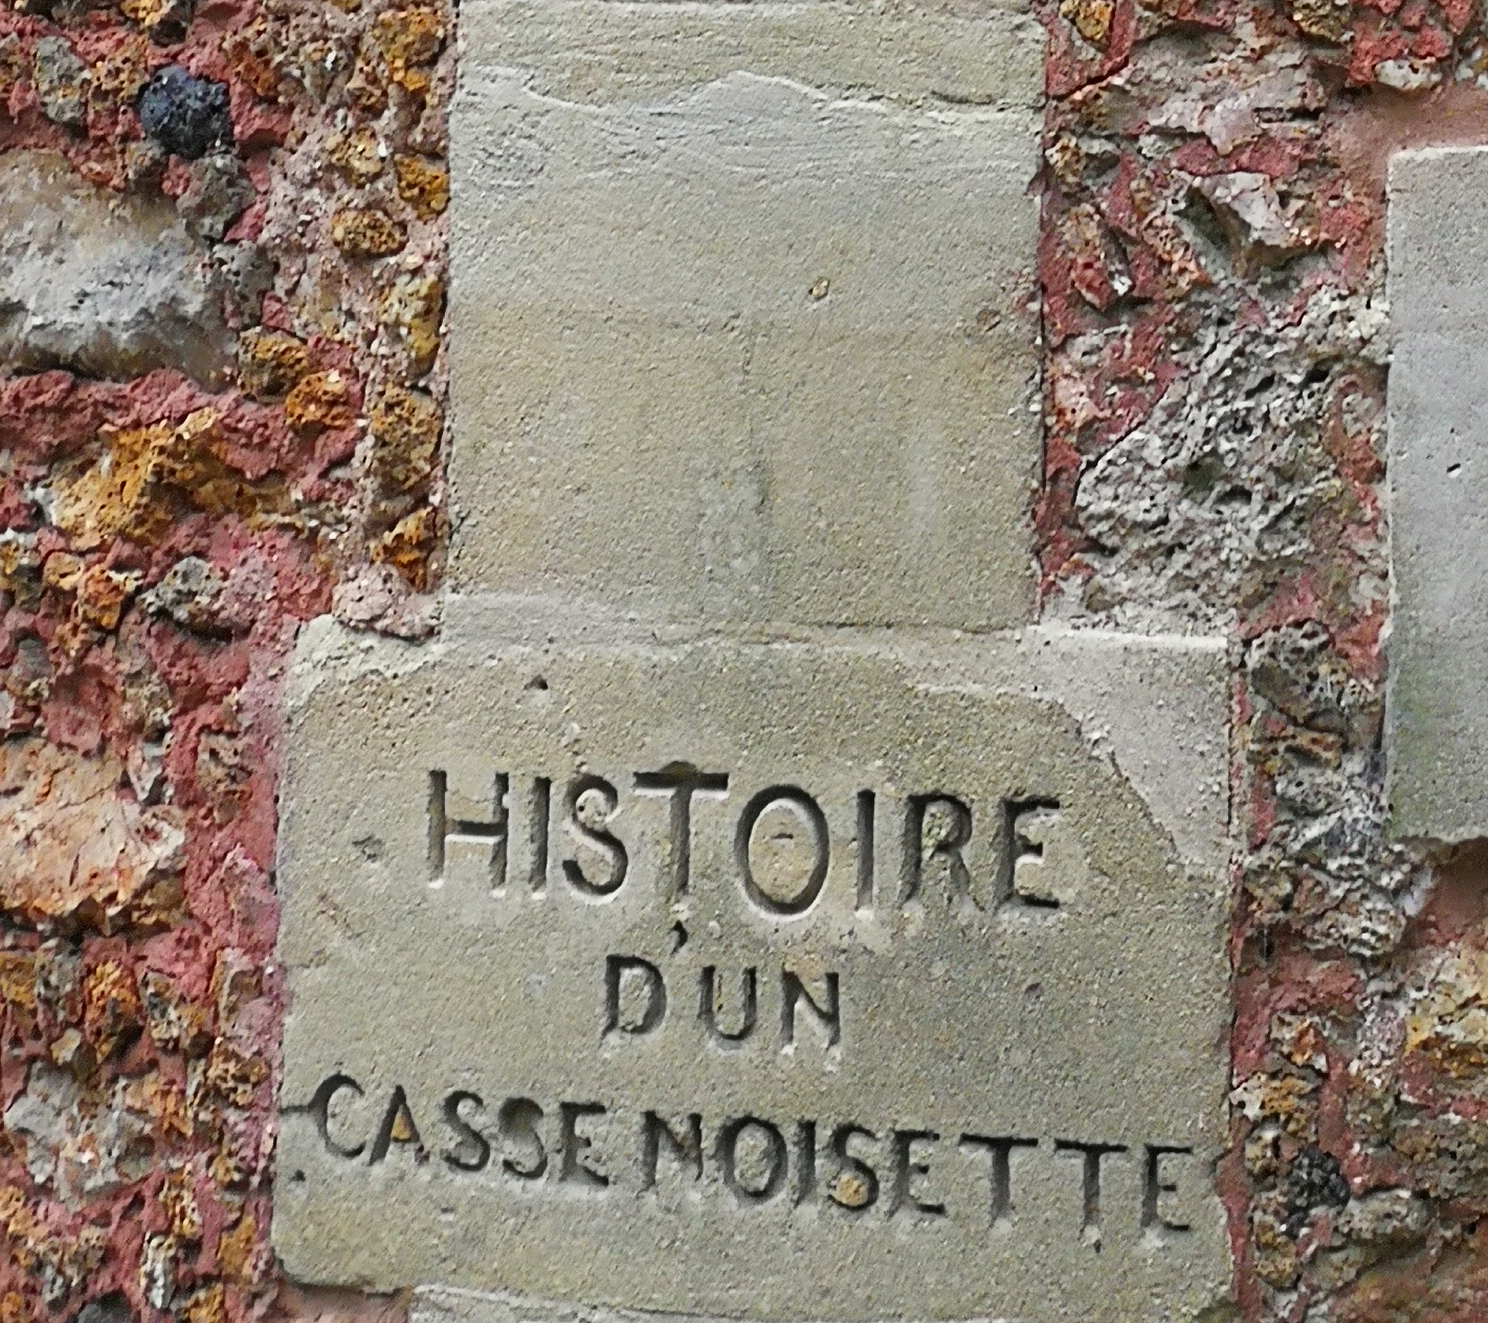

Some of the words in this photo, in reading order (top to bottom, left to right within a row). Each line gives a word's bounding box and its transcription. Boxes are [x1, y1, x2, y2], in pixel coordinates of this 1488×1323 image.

[427, 762, 1061, 916] HISTOIRE
[603, 921, 842, 1050] D'UN
[314, 1074, 610, 1189] CASSE
[640, 1109, 1192, 1237] NOISETTE
